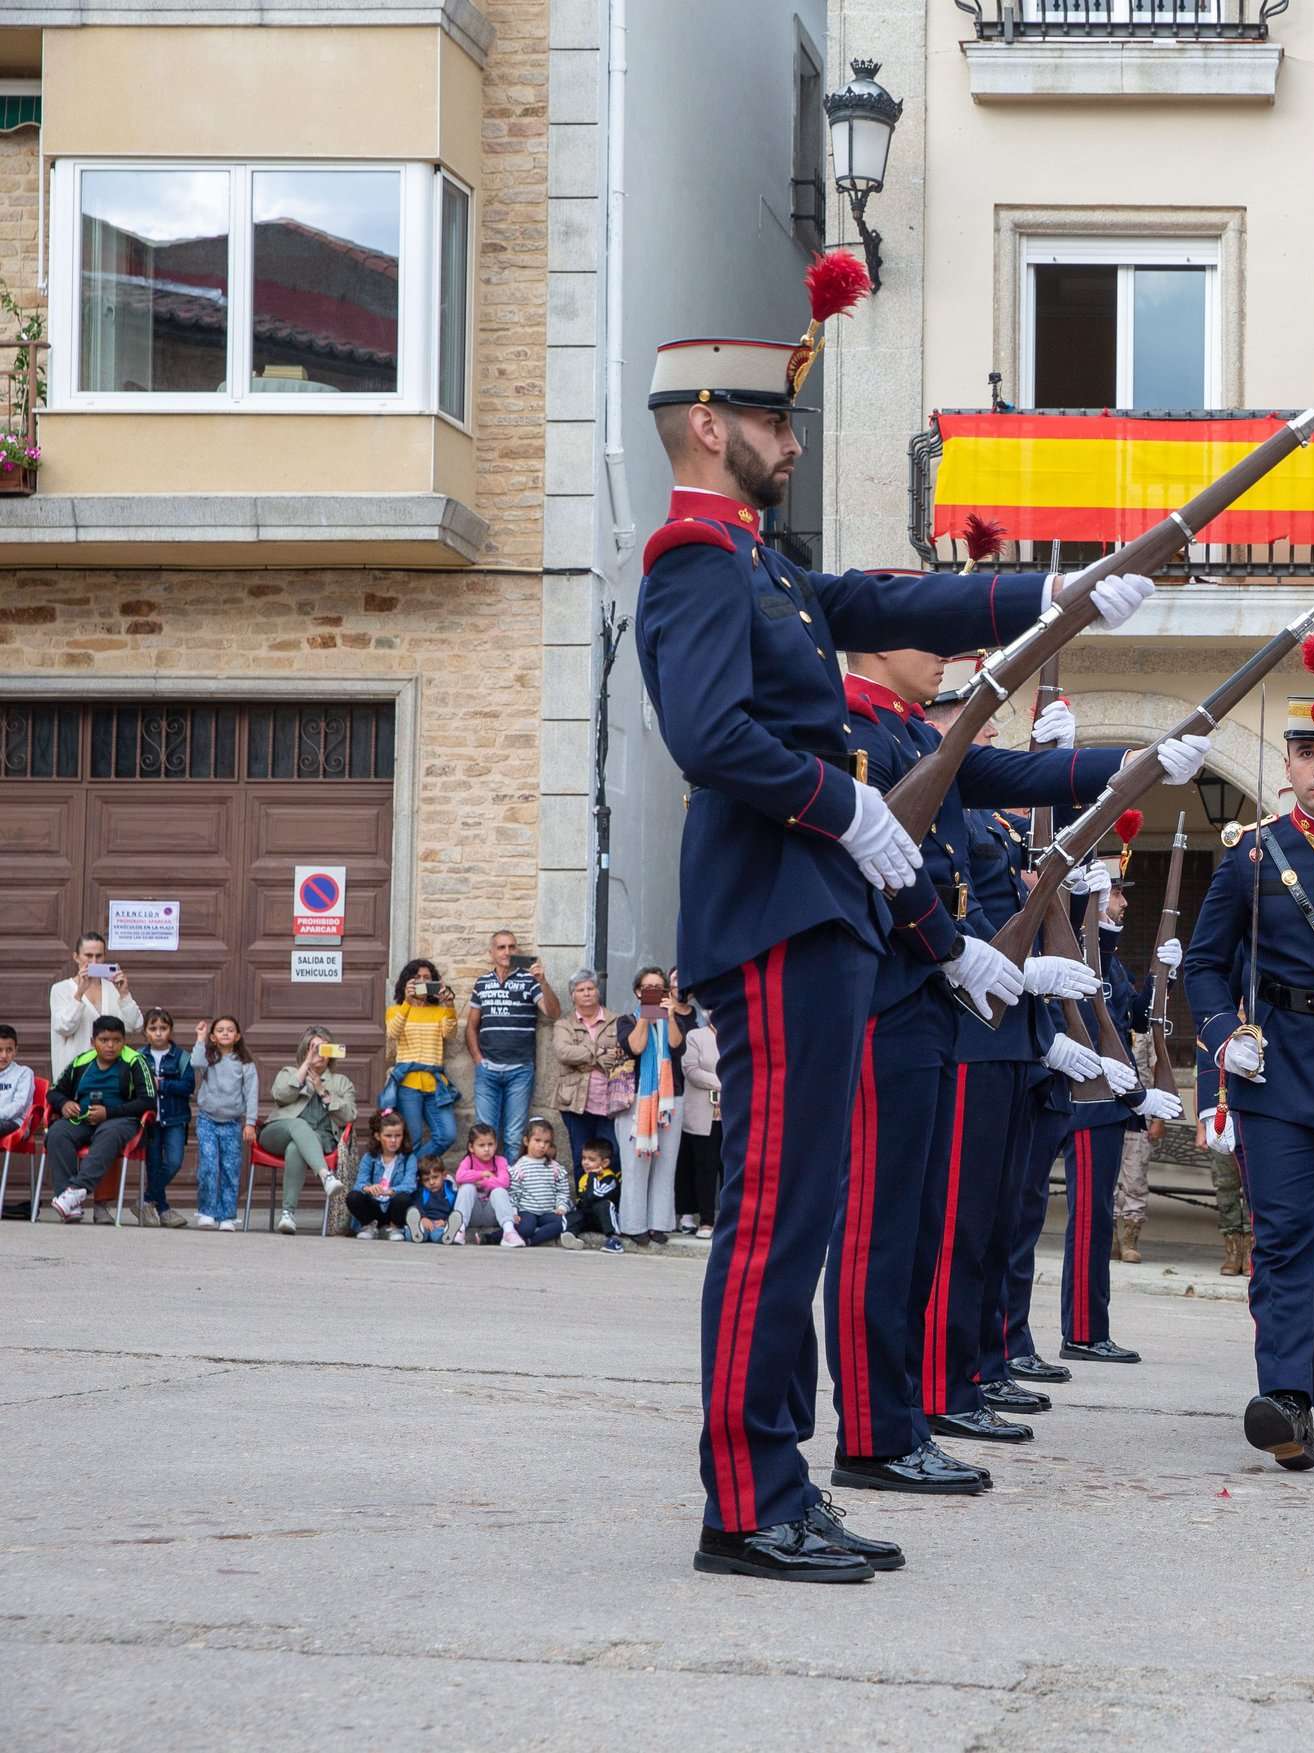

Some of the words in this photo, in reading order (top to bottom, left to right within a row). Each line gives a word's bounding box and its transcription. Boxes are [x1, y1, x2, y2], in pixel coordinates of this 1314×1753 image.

[298, 956, 324, 965] SALIDA
[326, 956, 337, 965] DE
[295, 967, 339, 977] VEHÍCULOS
[490, 1006, 511, 1016] N.Y.C.
